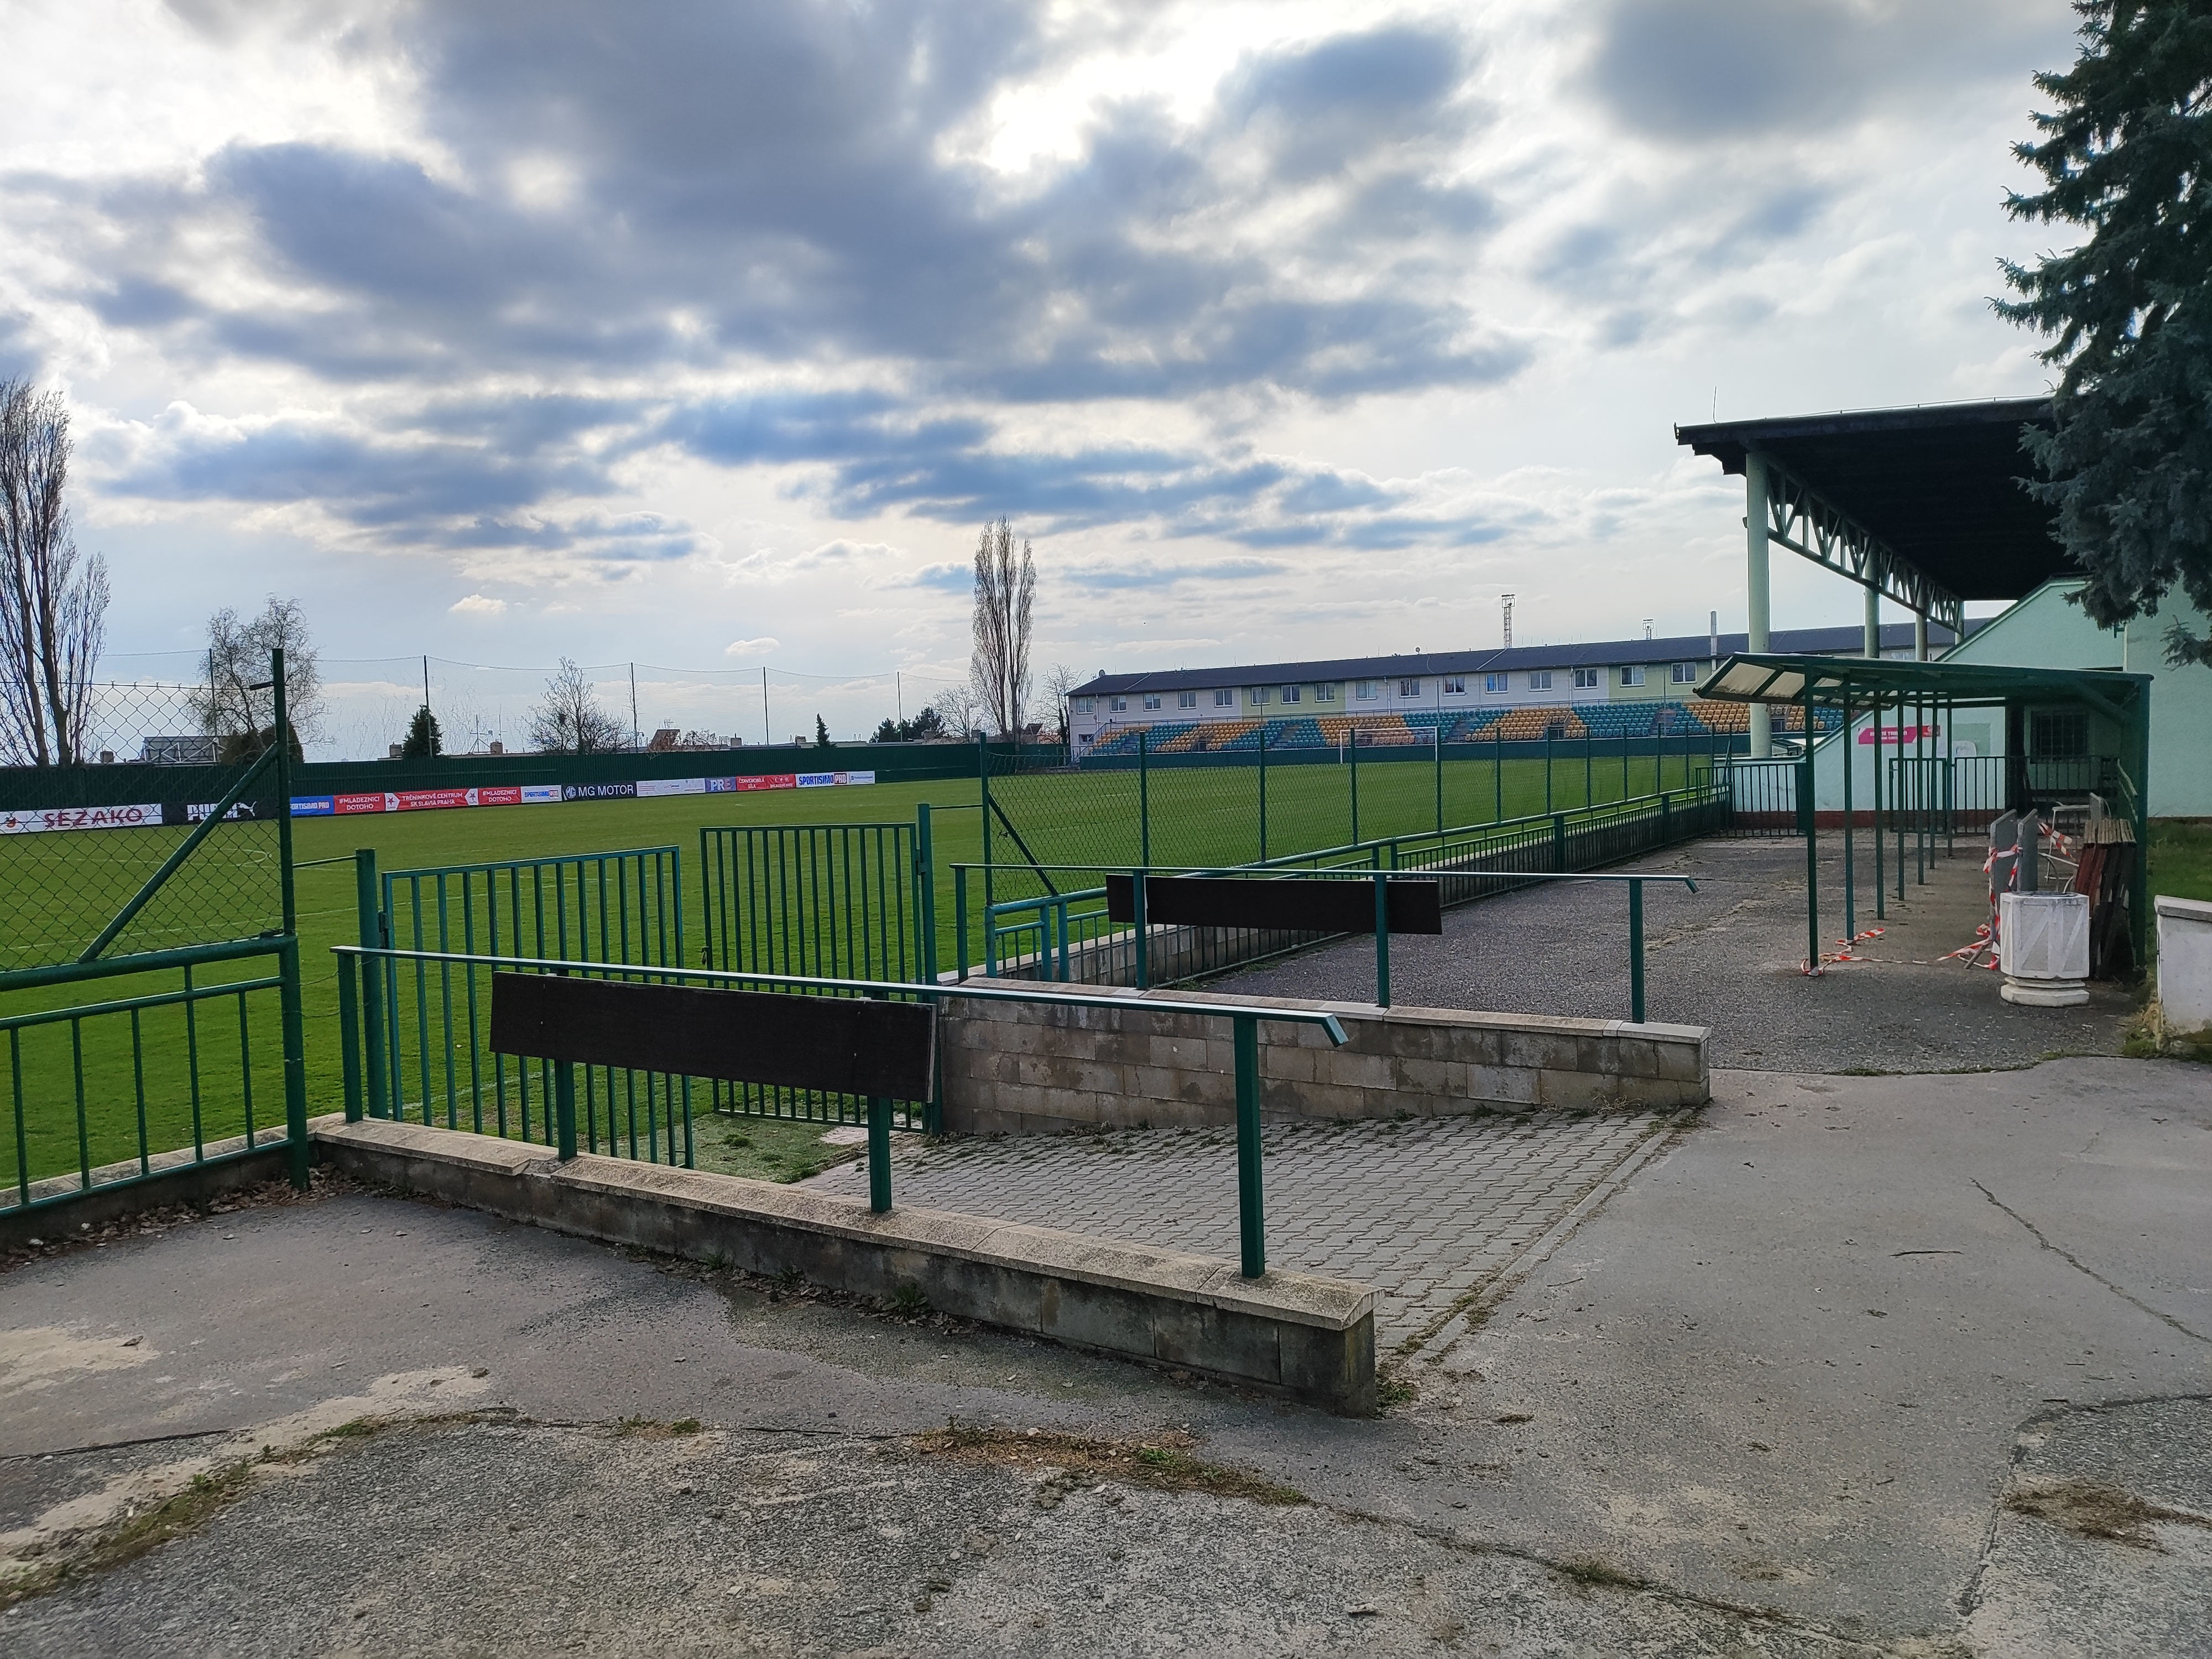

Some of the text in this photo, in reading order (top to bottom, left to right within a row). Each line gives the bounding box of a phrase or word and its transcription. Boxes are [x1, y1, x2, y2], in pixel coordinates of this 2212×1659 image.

[710, 779, 731, 791] PRE
[799, 773, 847, 785] SPORTISIMO PRO
[401, 792, 436, 801] TRÉNINKOVÉ
[578, 786, 596, 797] MG
[598, 784, 634, 796] MOTOR
[44, 808, 143, 827] SEZAKO
